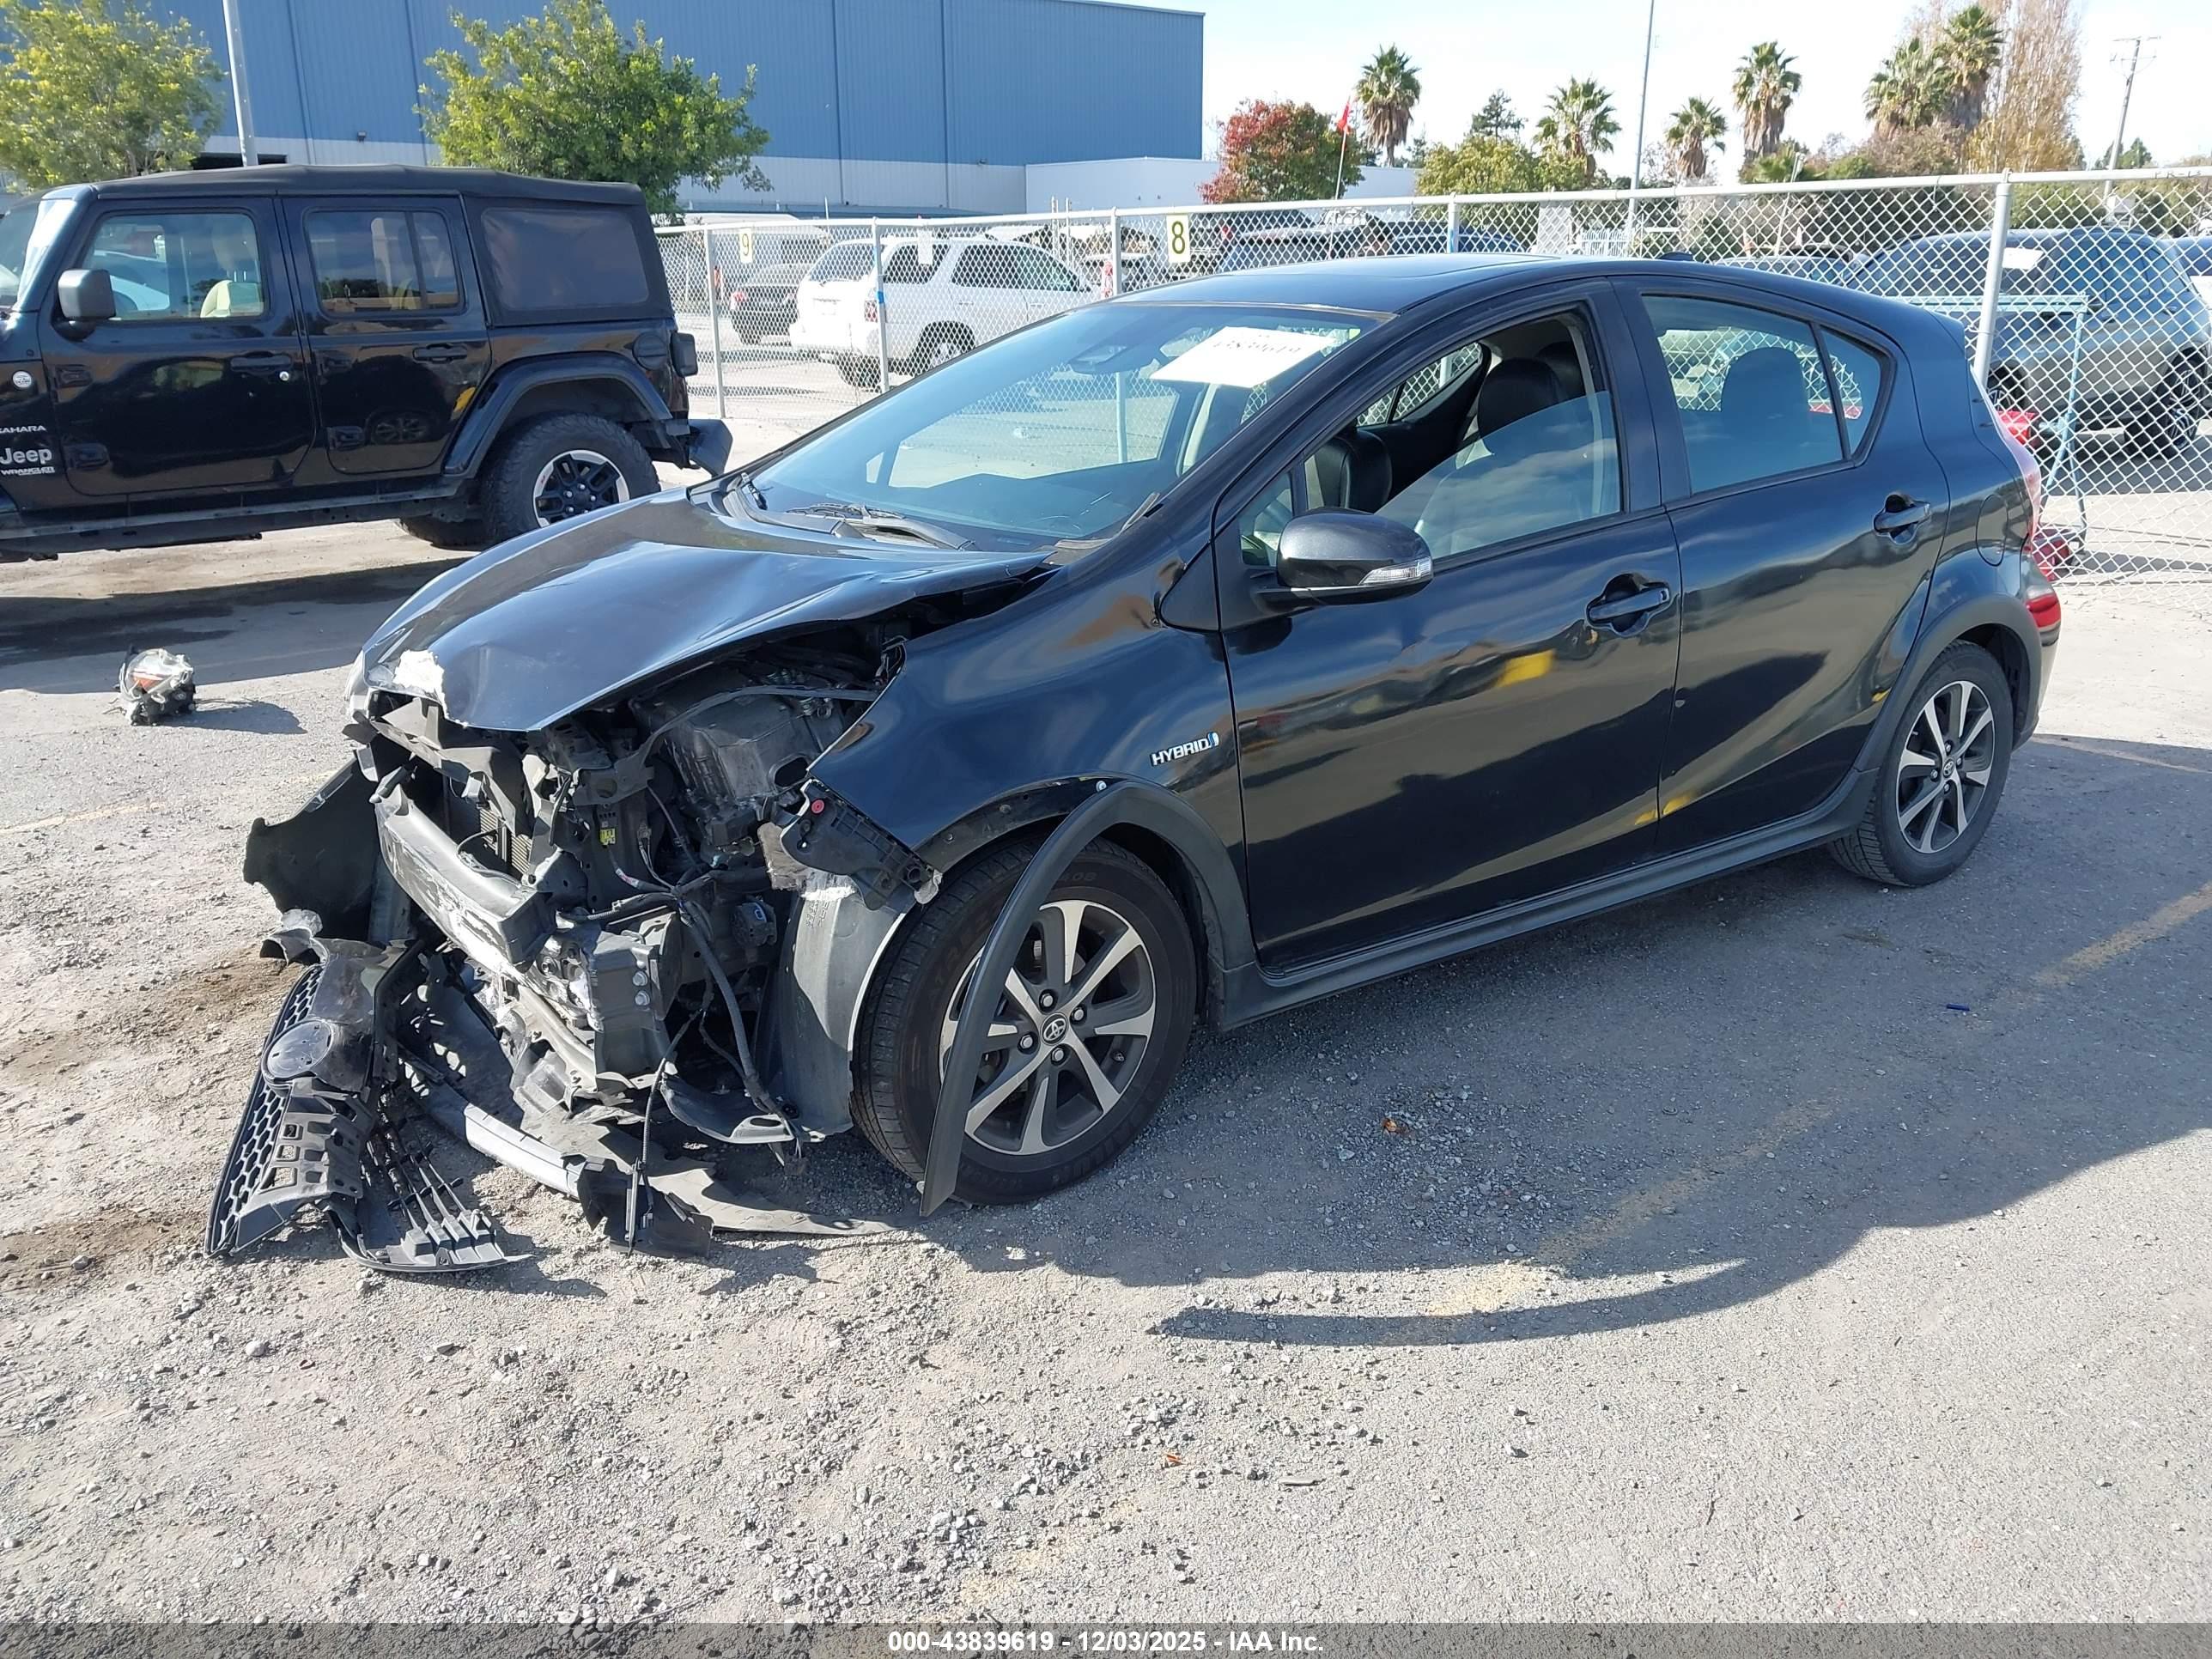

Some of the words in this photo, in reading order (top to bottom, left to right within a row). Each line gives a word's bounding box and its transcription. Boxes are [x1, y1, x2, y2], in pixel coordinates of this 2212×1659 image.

[742, 233, 749, 256] 9
[1171, 220, 1186, 254] 8
[0, 447, 52, 465] Jeep
[1152, 738, 1212, 766] HYBRID
